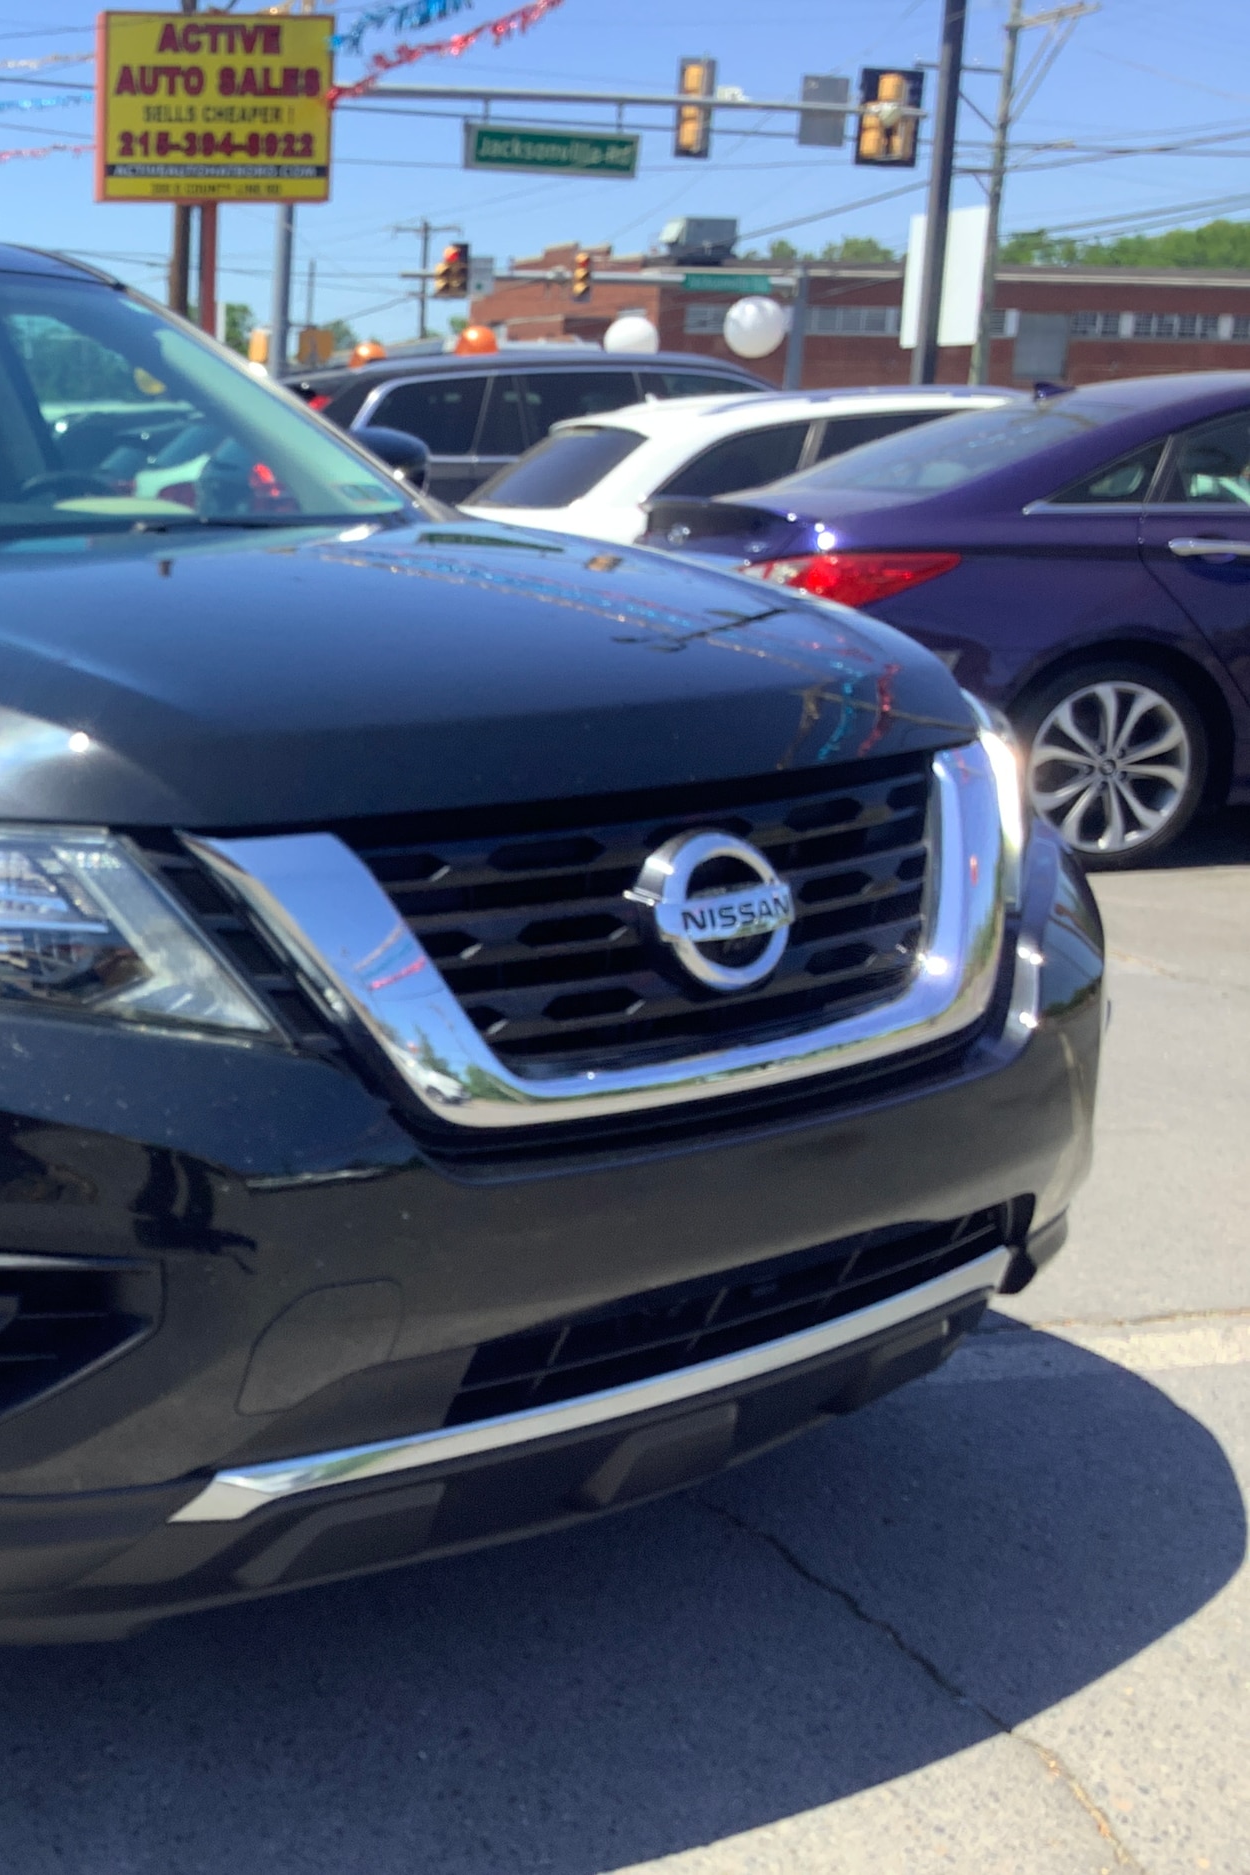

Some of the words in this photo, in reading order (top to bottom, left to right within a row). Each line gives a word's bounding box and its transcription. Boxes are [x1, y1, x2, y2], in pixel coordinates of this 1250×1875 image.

[157, 23, 281, 54] ACTIVE
[115, 66, 204, 96] AUTO
[218, 67, 320, 97] SALES
[144, 105, 197, 123] SELLS
[202, 106, 282, 124] CHEAPER
[681, 894, 790, 931] NISSAN
